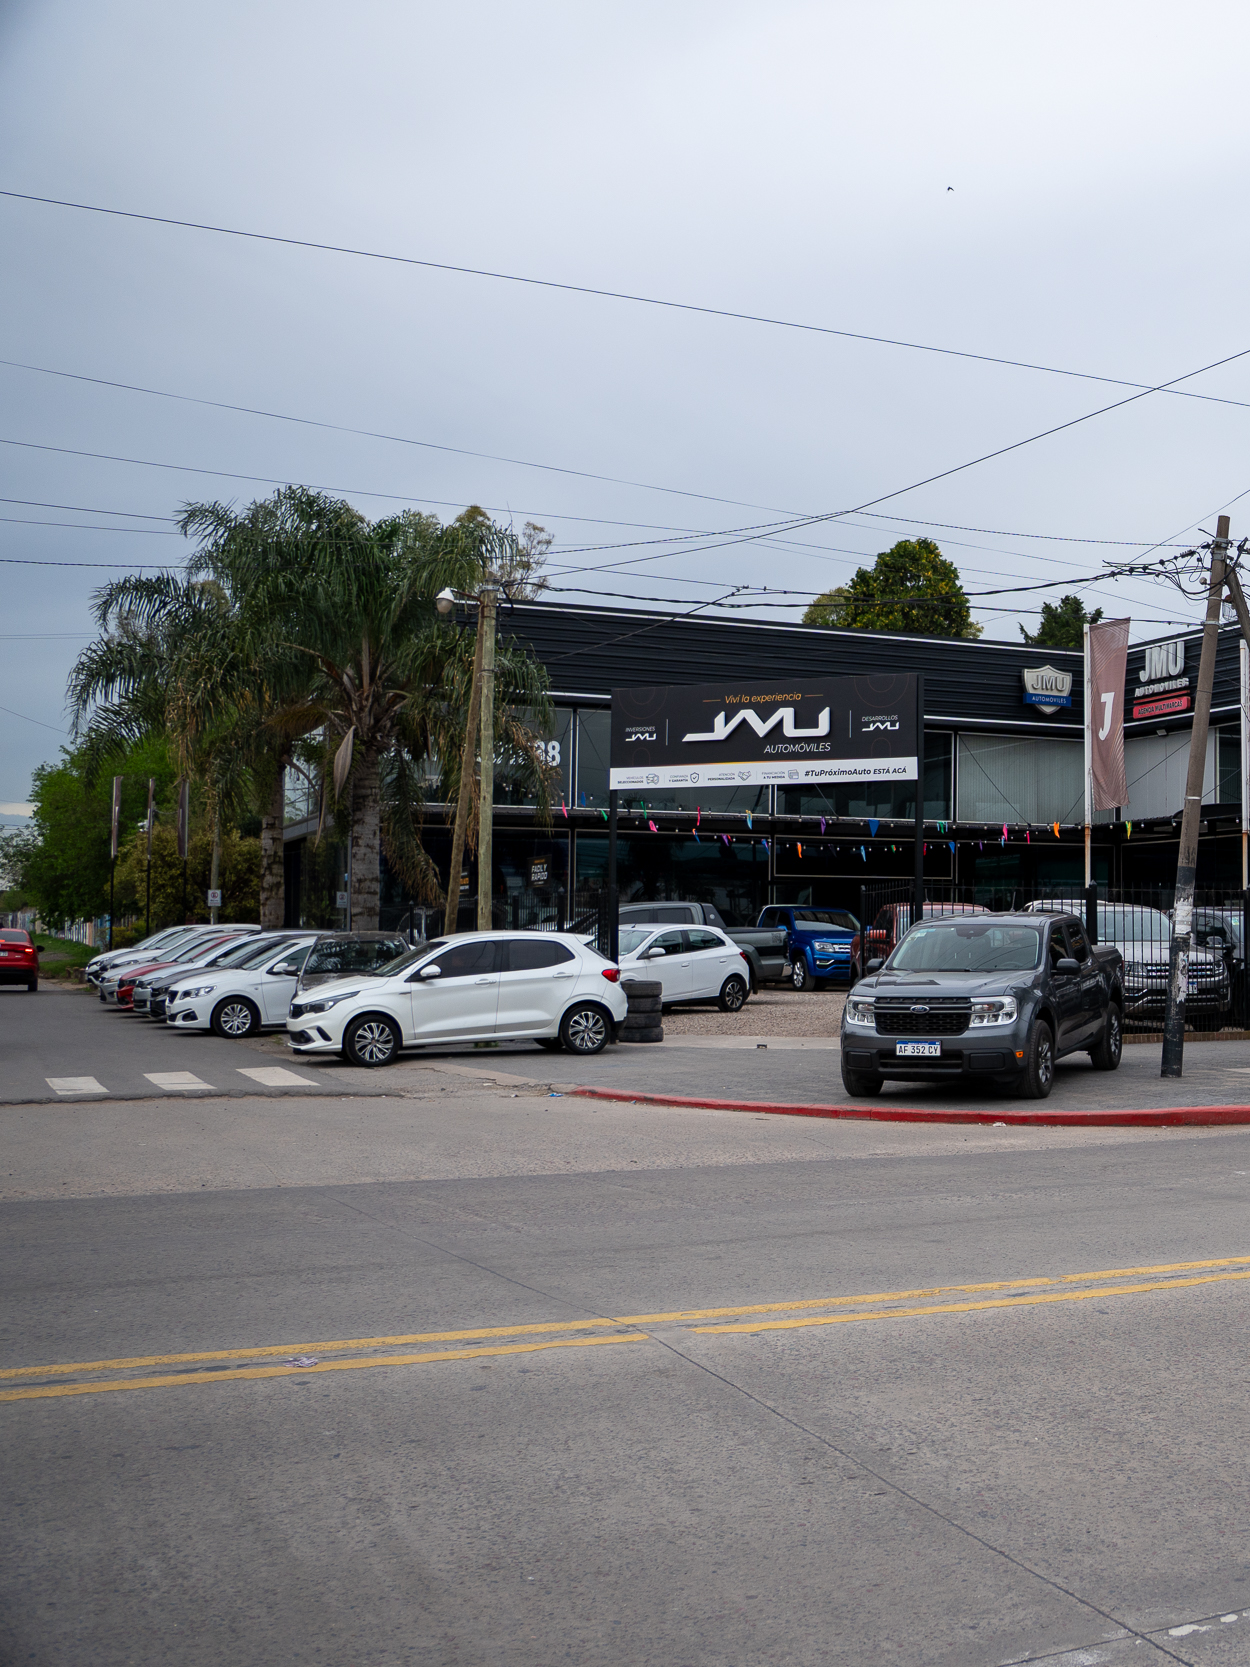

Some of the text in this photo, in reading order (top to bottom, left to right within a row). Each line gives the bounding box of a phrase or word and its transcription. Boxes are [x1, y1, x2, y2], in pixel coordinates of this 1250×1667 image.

[1139, 641, 1185, 682] JMU
[1031, 674, 1067, 692] JMU
[725, 692, 802, 704] Viví la experiencia
[1138, 700, 1183, 715] AGENCIA MULTIMARCAS
[861, 714, 898, 722] DESARROLLOS
[1098, 692, 1115, 741] J
[625, 725, 656, 733] INVERSIONES
[763, 742, 831, 754] AUTOMÓVILES
[804, 765, 907, 777] #TuPróximoAuto ESTÁ ACÁ
[898, 1045, 939, 1055] AF 352 CY
